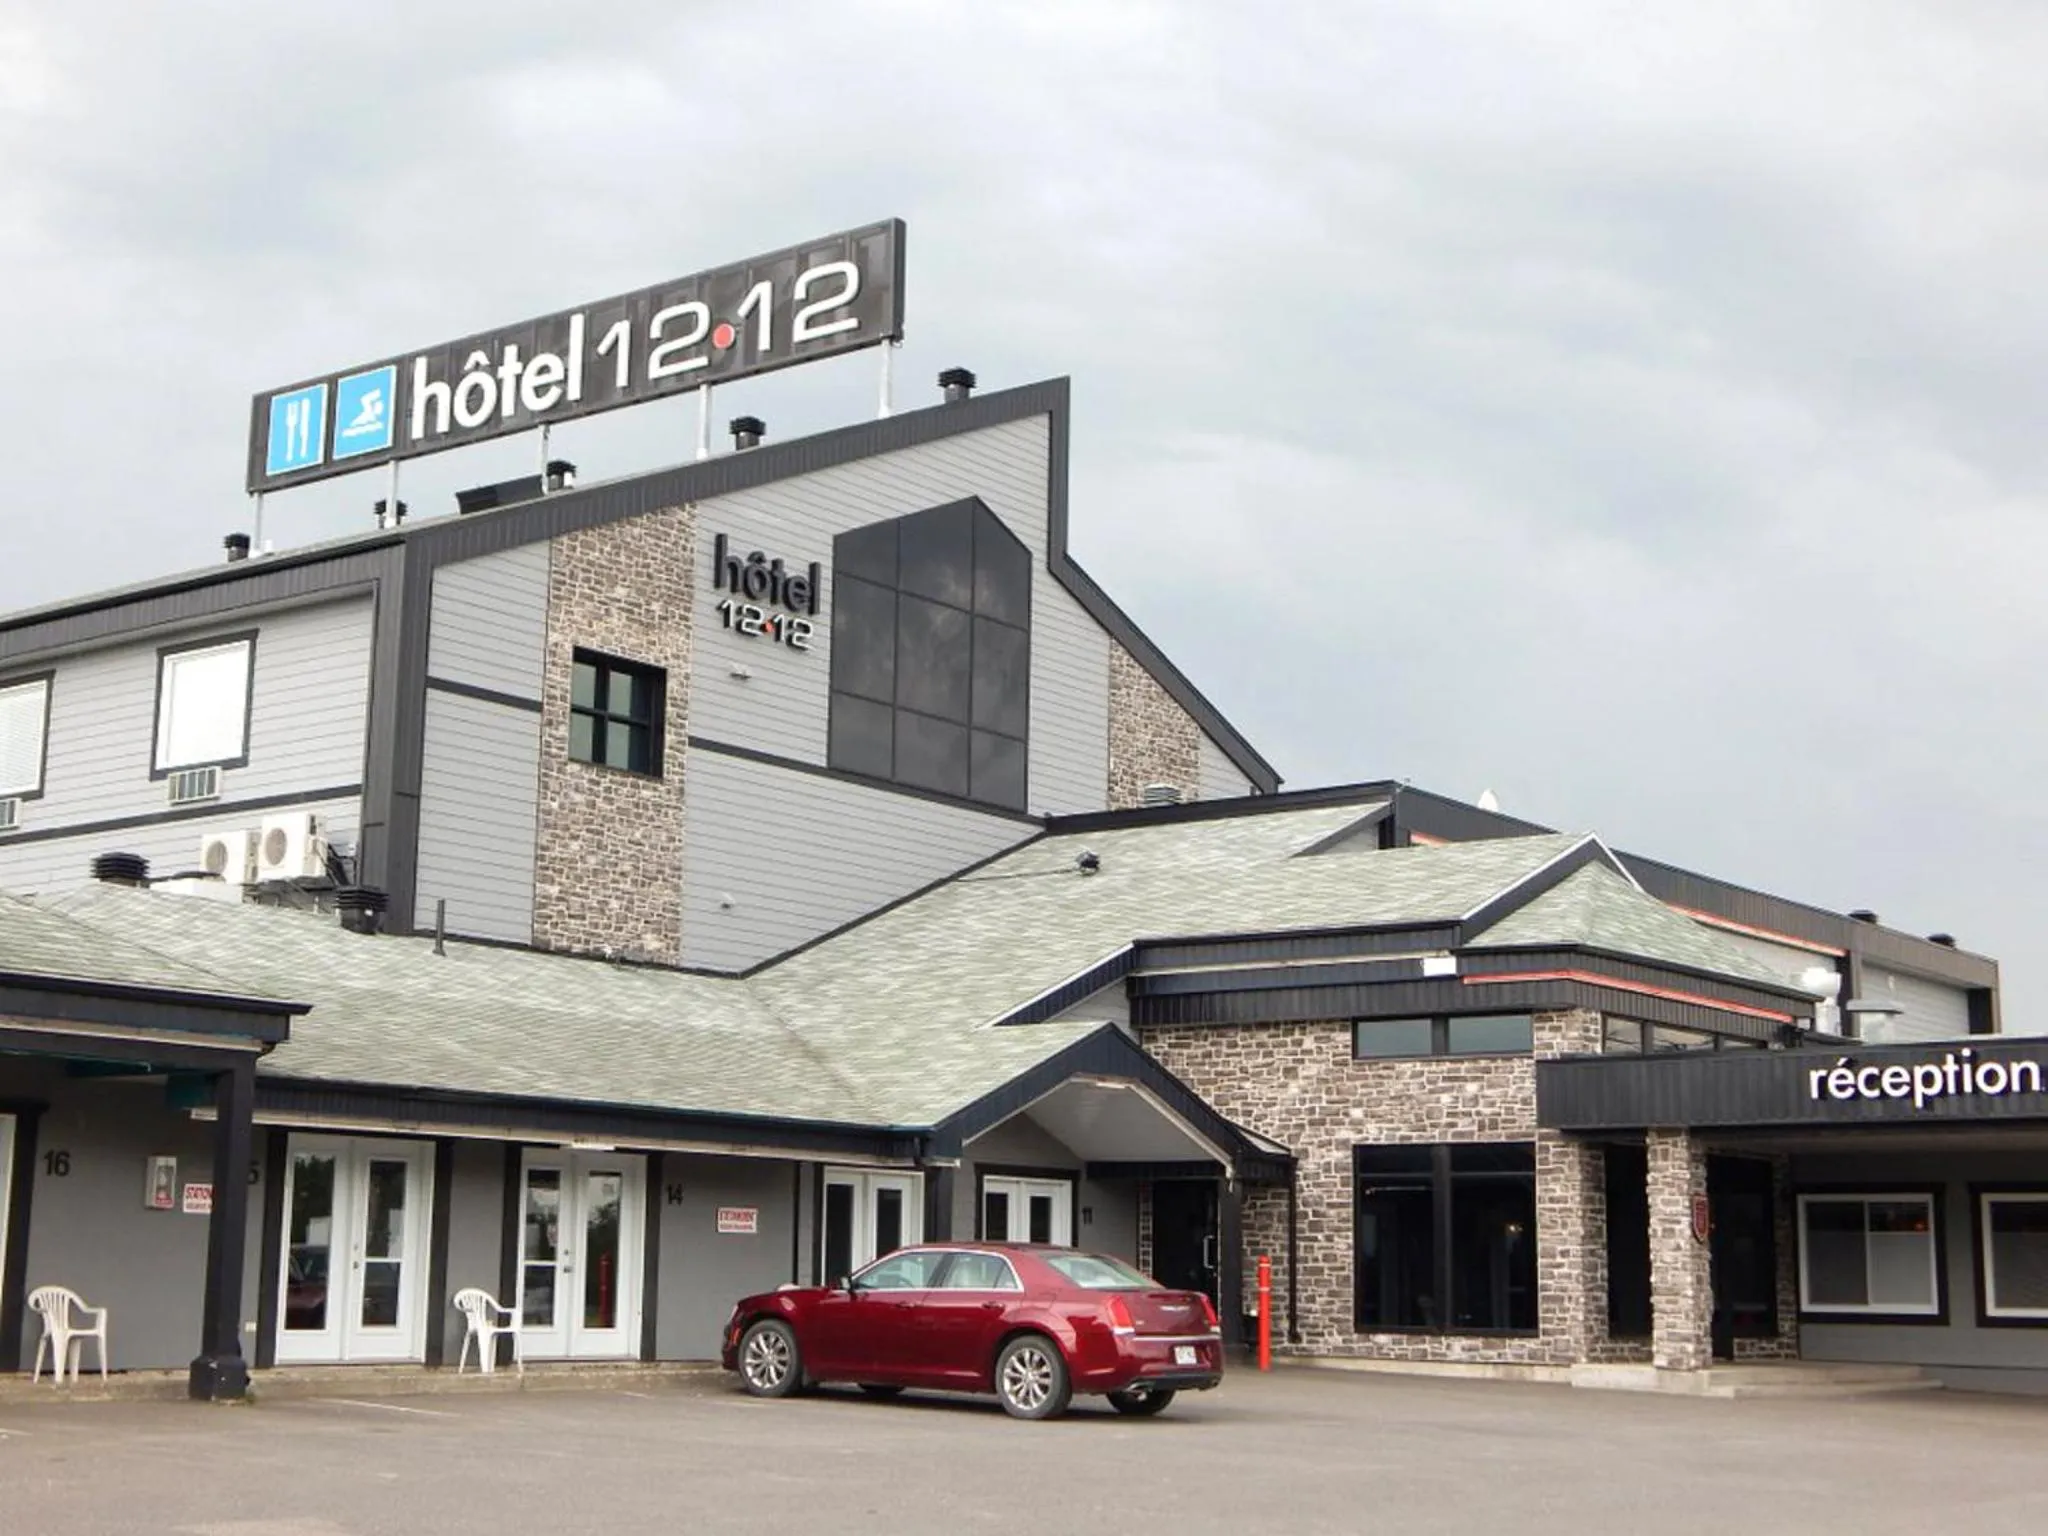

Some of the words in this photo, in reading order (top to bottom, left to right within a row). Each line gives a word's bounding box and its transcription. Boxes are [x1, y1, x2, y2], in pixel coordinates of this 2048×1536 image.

[411, 313, 584, 440] hôtel
[713, 533, 822, 616] hôtel
[1809, 1047, 2041, 1108] réception
[44, 1150, 70, 1177] 16
[667, 1183, 684, 1206] 14
